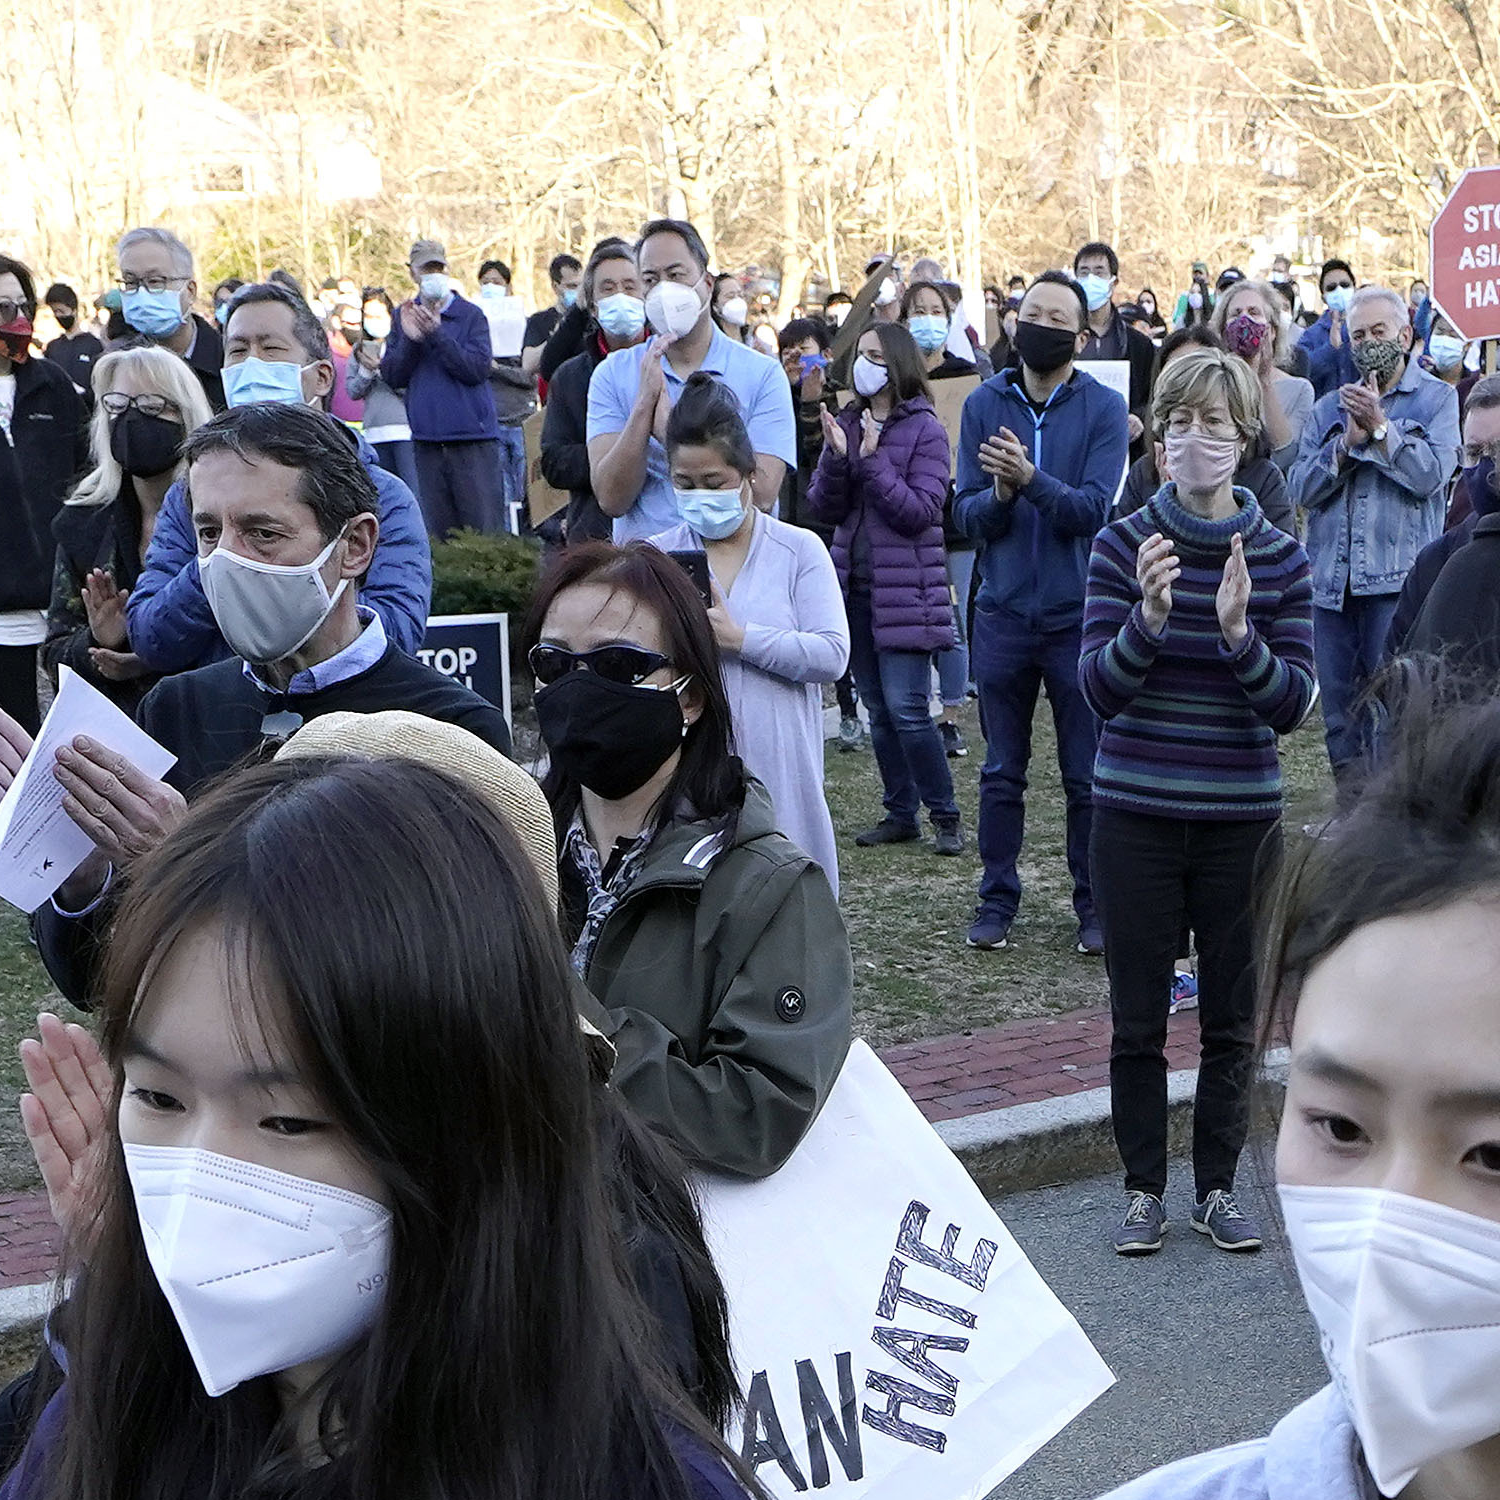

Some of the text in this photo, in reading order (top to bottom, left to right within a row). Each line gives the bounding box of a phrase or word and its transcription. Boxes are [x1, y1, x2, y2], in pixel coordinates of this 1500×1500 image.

[415, 646, 478, 676] TOP
[356, 1272, 390, 1294] N9
[862, 1200, 999, 1453] HATE
